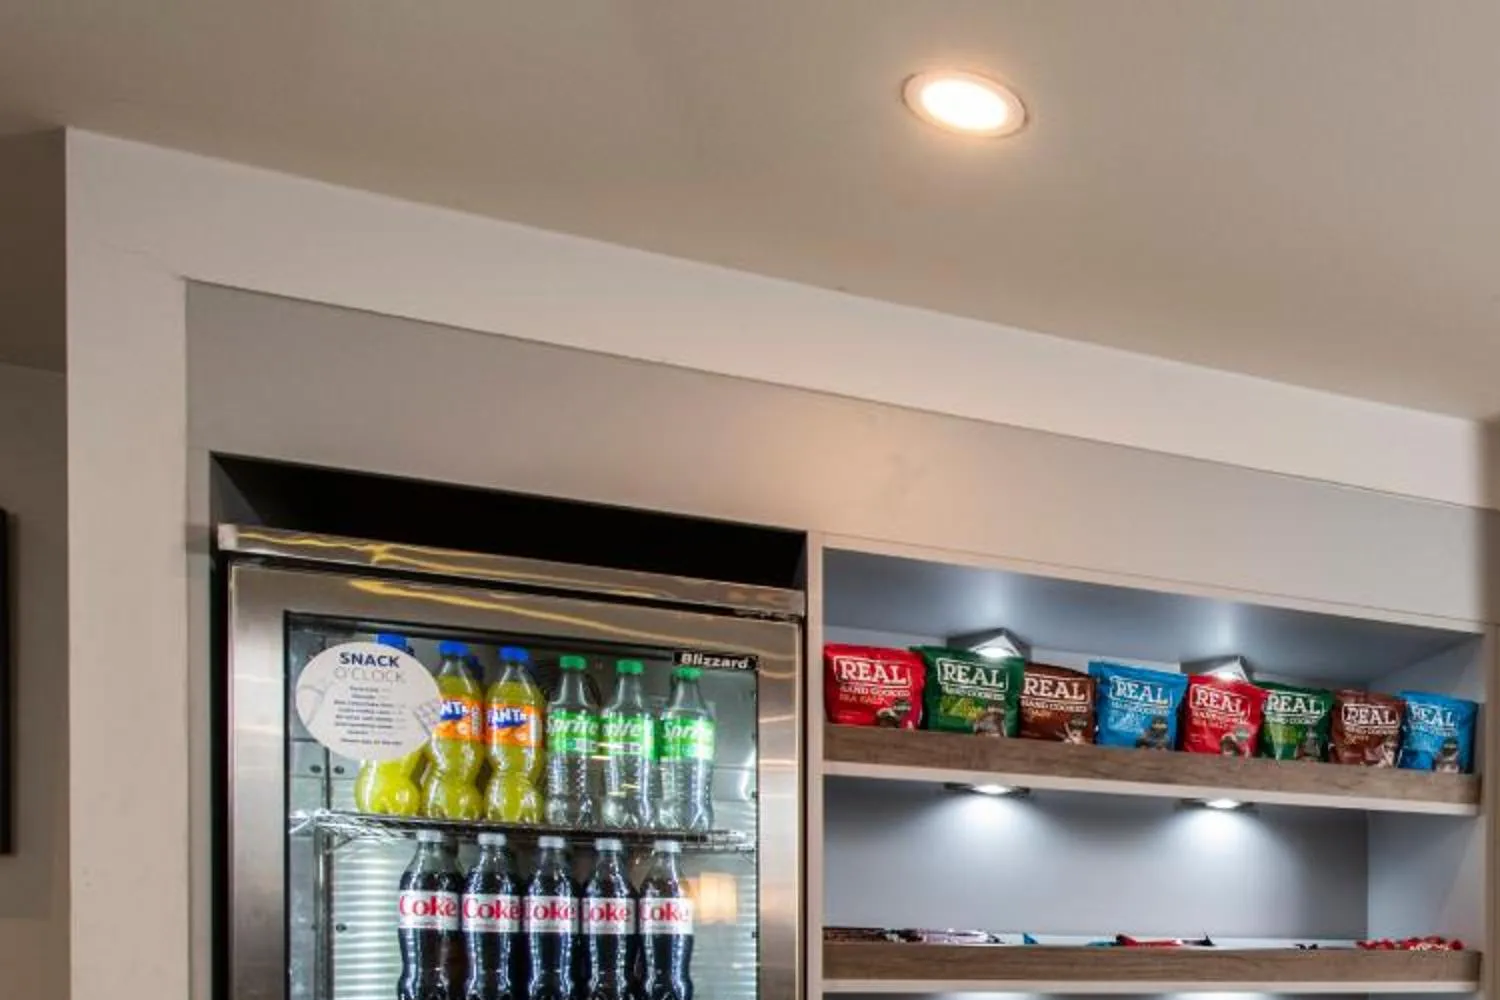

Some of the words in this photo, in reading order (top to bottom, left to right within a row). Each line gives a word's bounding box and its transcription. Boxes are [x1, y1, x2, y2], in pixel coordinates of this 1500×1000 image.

[339, 652, 400, 668] SNACK
[681, 651, 750, 669] Blizzard
[840, 659, 907, 685] REAL
[942, 663, 1005, 688] REAL
[1023, 677, 1085, 700] REAL
[1115, 681, 1169, 705] REAL
[1195, 688, 1247, 717] REAL
[1267, 694, 1321, 714] REAL
[1346, 706, 1396, 726] REAL
[1409, 704, 1455, 727] REAL
[400, 895, 457, 917] Coke
[463, 897, 521, 920] Coke
